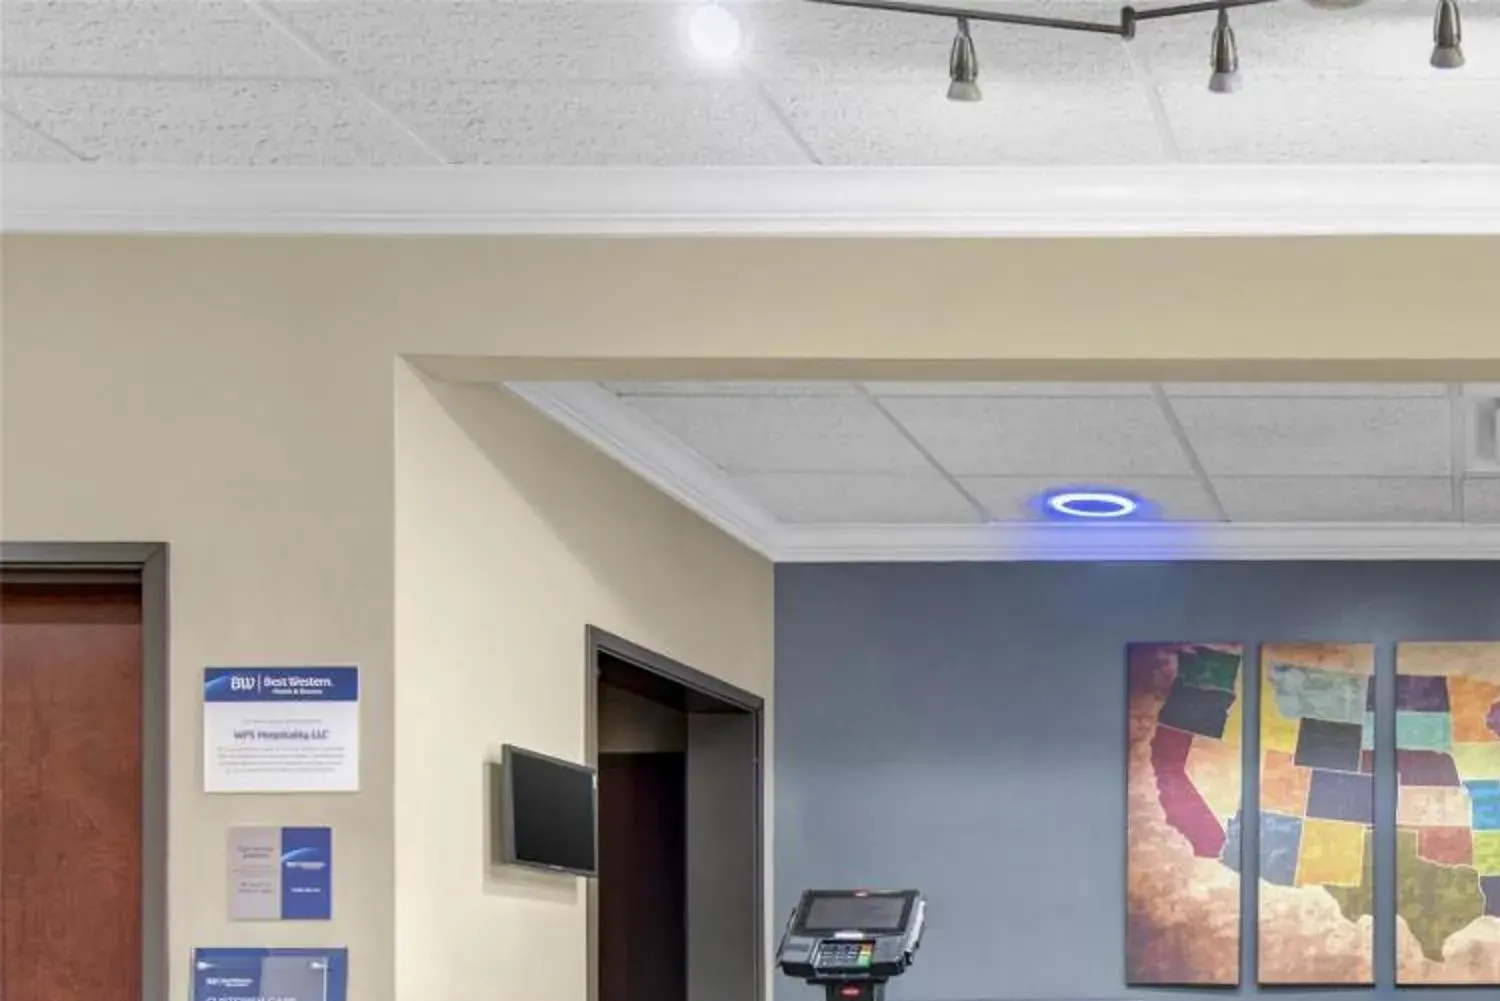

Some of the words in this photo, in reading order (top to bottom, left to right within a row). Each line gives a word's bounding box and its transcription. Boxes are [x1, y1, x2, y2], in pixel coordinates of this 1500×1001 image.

[230, 675, 255, 691] BW
[263, 675, 287, 687] Best
[287, 675, 331, 687] Western
[257, 728, 309, 742] Hospitality
[311, 728, 330, 740] LLC
